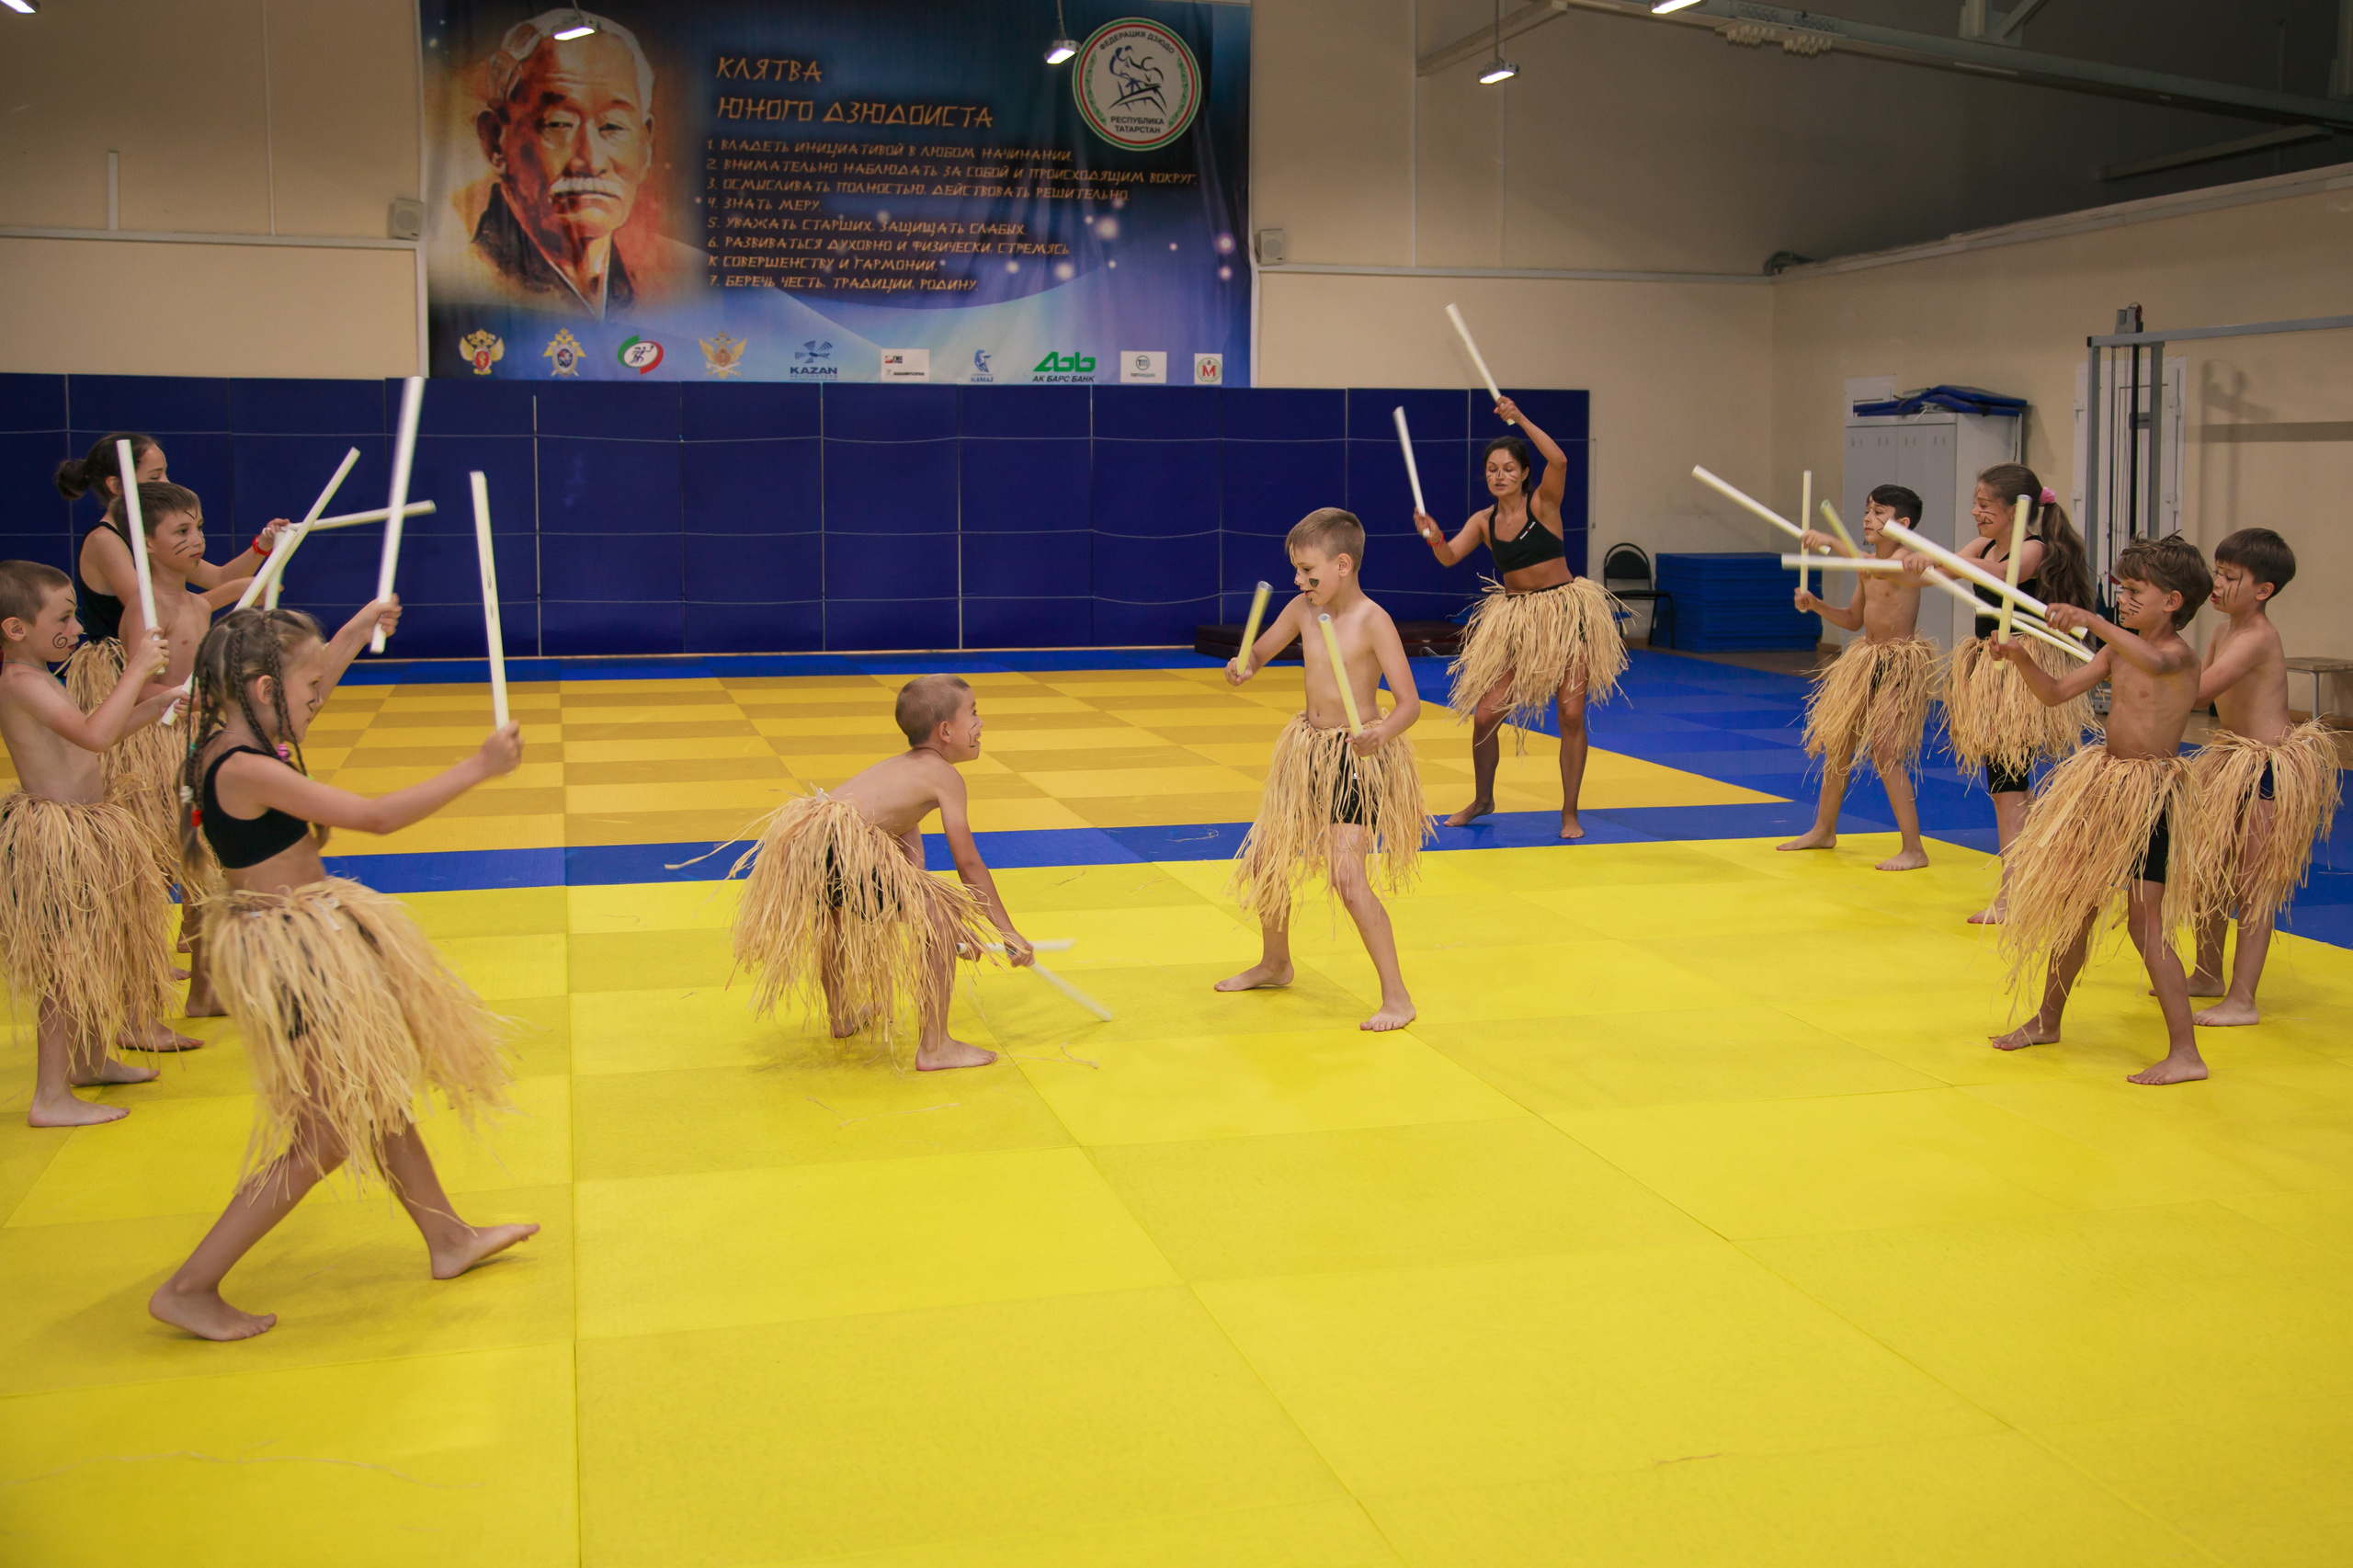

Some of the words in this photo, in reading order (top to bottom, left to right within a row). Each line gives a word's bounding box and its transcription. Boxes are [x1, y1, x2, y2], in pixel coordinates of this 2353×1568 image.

[1099, 30, 1146, 50] ФЕДЕРАЦИЯ
[1147, 33, 1176, 54] ДЗЮДО
[716, 56, 823, 83] КЛЯТВА
[717, 97, 814, 121] ЮНОГО
[823, 101, 994, 128] ДЗЮДОИСТА
[1110, 116, 1165, 125] РЕСПУБЛИКА
[1115, 125, 1161, 133] ТАТАРСТАН
[721, 139, 790, 153] ВЛАДЕТЬ
[794, 142, 904, 158] ИНИЦИАТИВОЙ
[909, 145, 916, 156] В
[920, 146, 975, 159] ЛЮБОМ
[723, 159, 838, 174] ВНИМАТЕЛЬНО
[844, 163, 938, 176] НАБЛЮДАТЬ
[943, 165, 961, 177] ЗА
[967, 165, 1009, 178] СОБОЙ
[1014, 167, 1023, 178] И
[1029, 168, 1144, 185] ПРОИСХОДЯЩИМ
[723, 178, 831, 192] ОСМЫСЛИВАТЬ
[932, 183, 1030, 198] ДЕЙСТВОВАТЬ
[723, 198, 773, 210] ЗНАТЬ
[726, 217, 797, 230] УВАЖАТЬ
[880, 221, 964, 237] ЗАЩИЩАТЬ
[725, 236, 823, 250] РАЗВИВАТЬСЯ
[826, 239, 892, 252] ДУХОВНО
[897, 241, 907, 251] И
[997, 242, 1070, 255] СТРЕМЯСЬ
[708, 256, 719, 267] К
[723, 256, 835, 269] СОВЕРШЕНСТВУ
[838, 258, 850, 269] И
[725, 275, 776, 288] БЕРЕЧЬ
